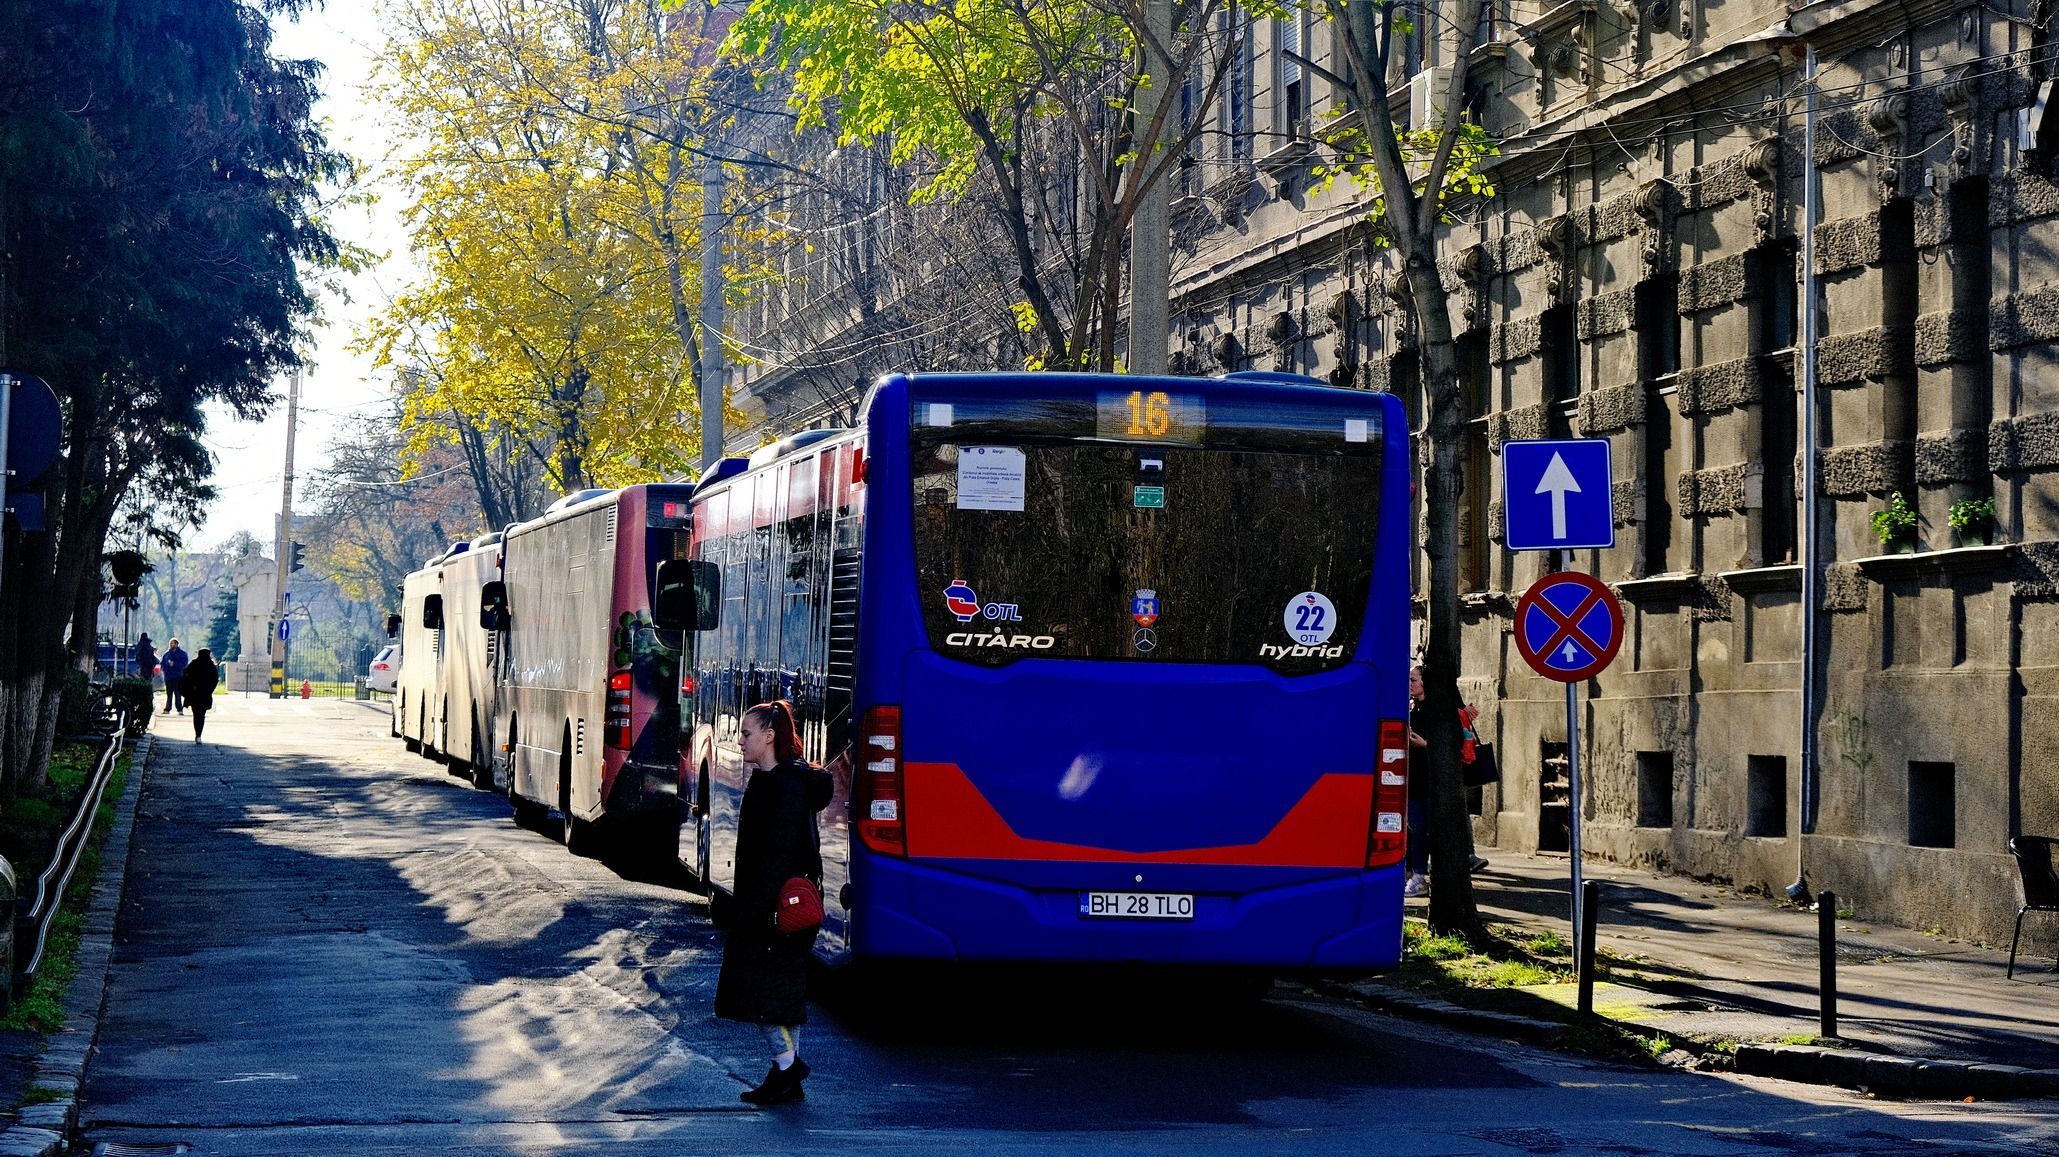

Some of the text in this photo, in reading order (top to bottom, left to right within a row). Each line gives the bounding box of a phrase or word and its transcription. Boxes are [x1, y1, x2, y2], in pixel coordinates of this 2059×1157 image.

[1126, 391, 1169, 436] 16
[983, 602, 1022, 621] OTL
[1295, 605, 1325, 631] 22
[1300, 634, 1319, 643] OTL
[1259, 643, 1344, 660] hybrid
[1080, 904, 1089, 913] RO
[1091, 895, 1191, 915] BH 28 TLO
